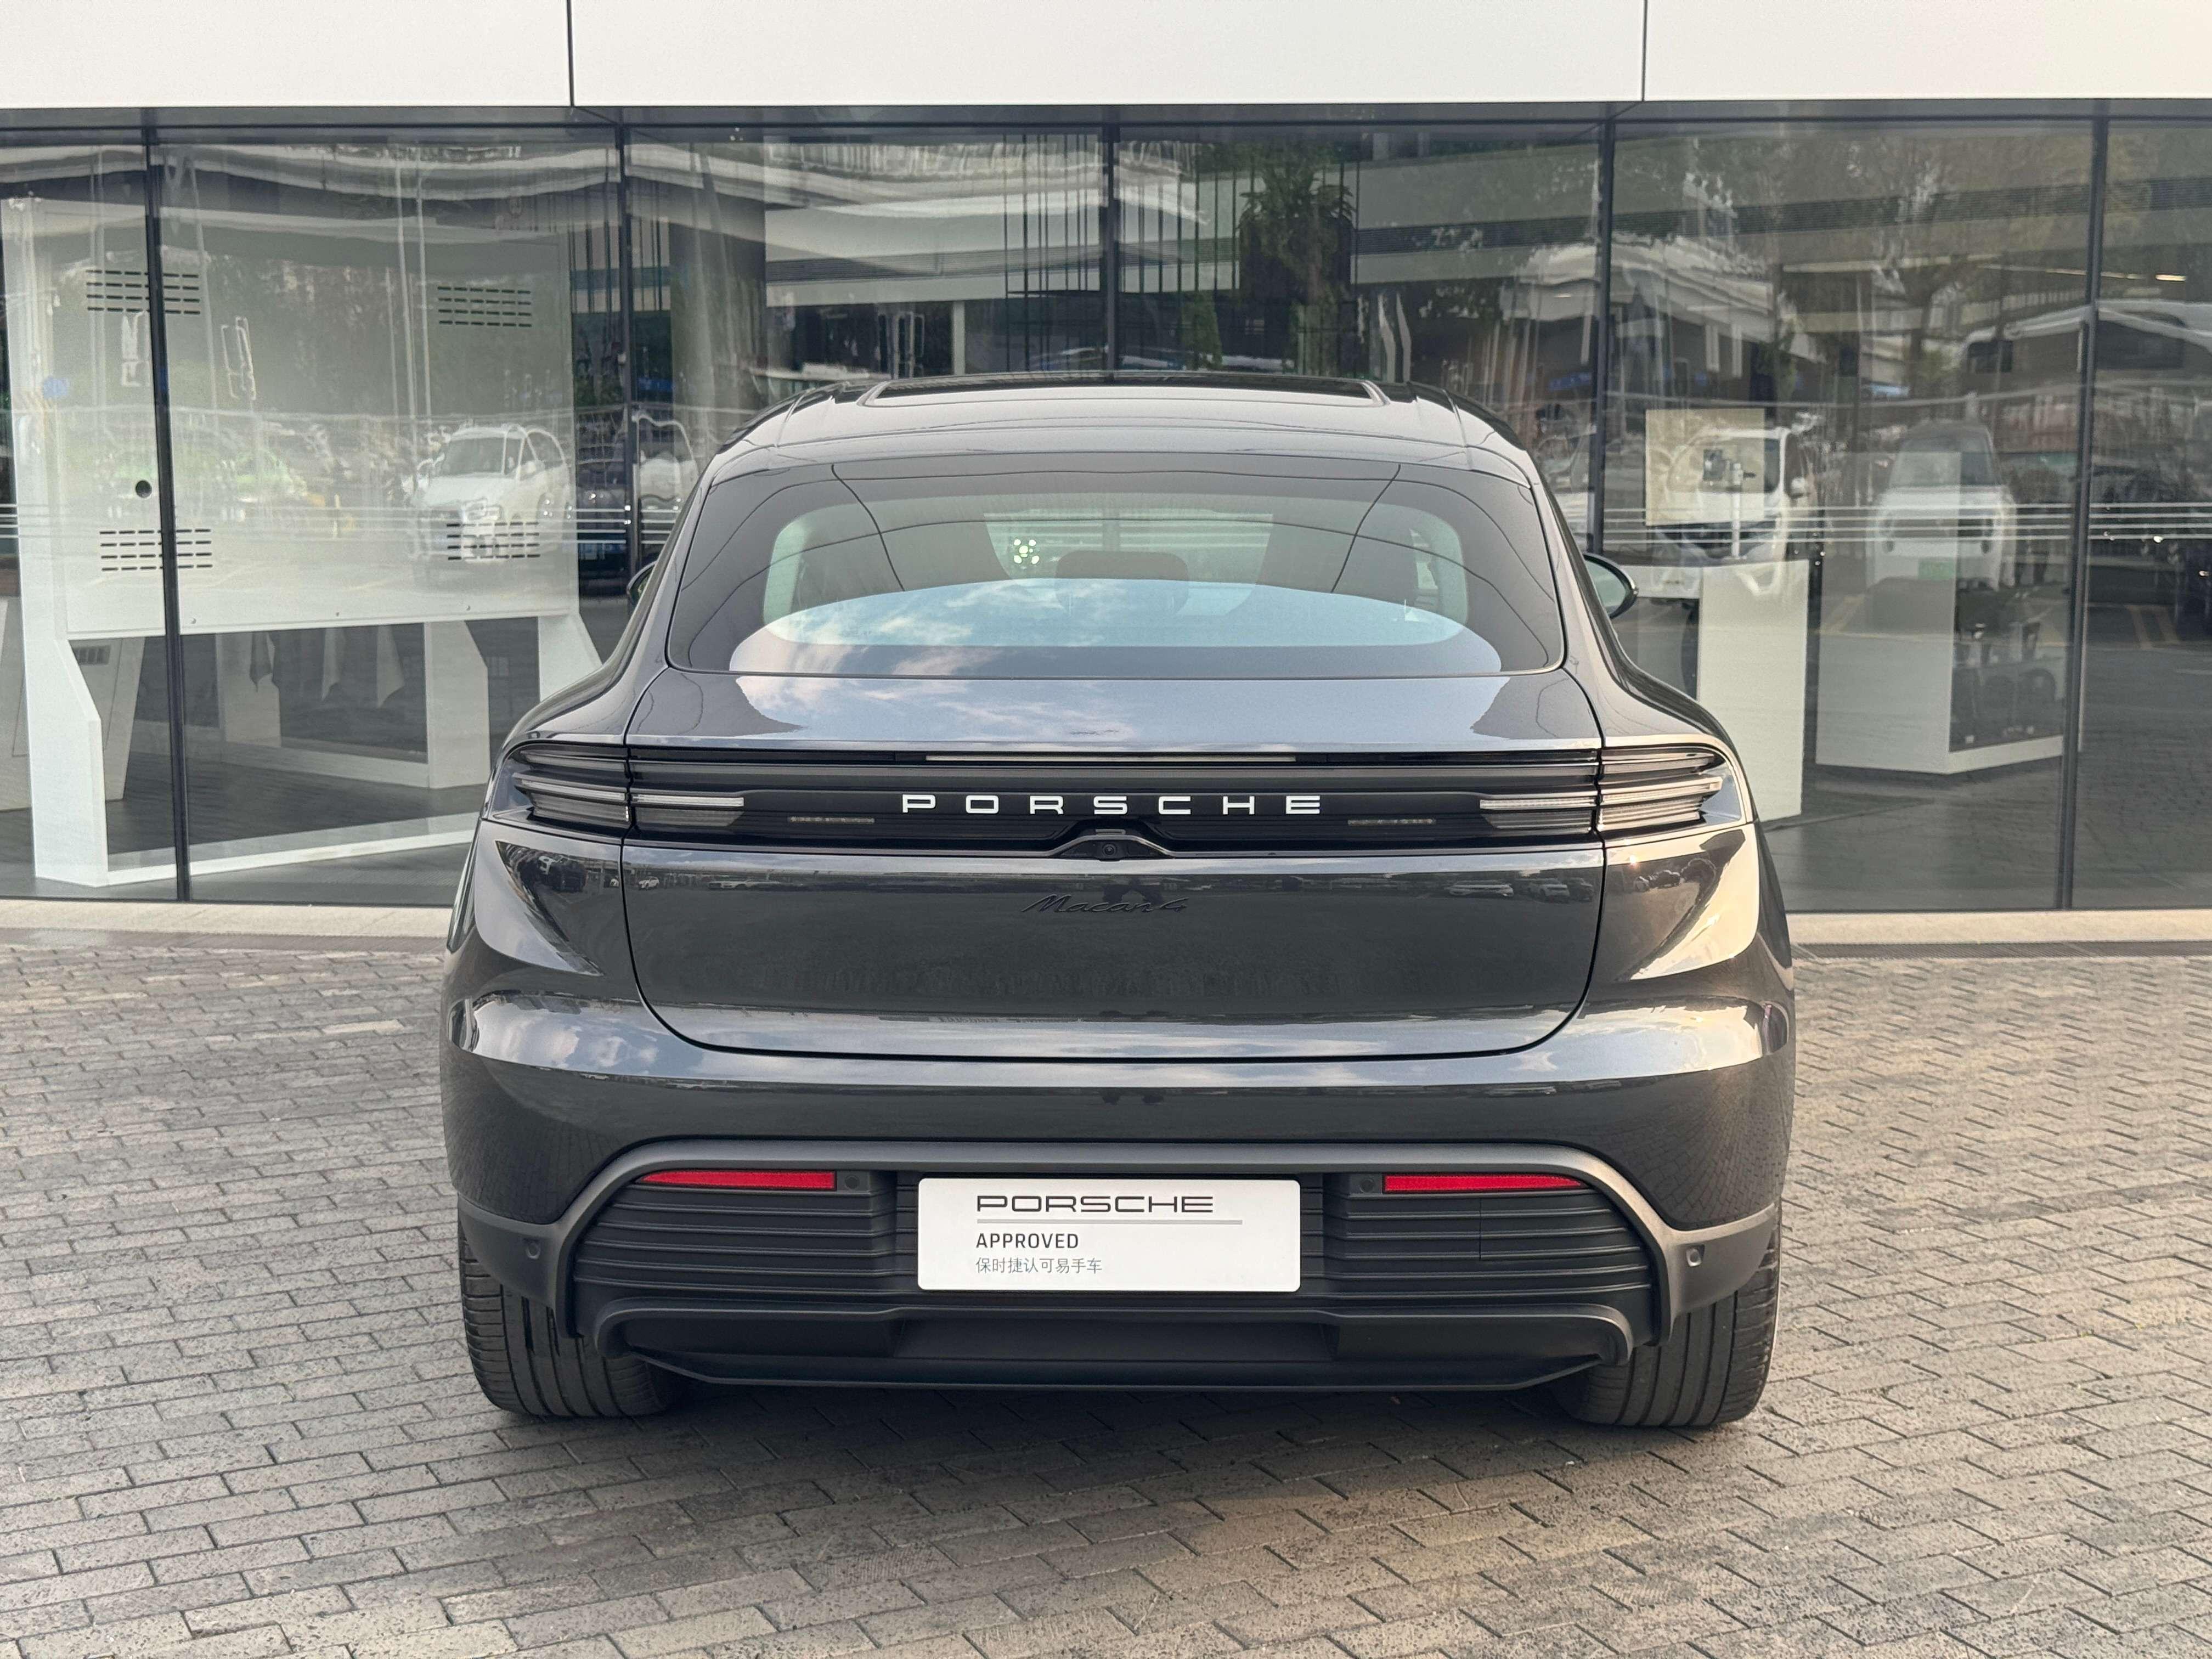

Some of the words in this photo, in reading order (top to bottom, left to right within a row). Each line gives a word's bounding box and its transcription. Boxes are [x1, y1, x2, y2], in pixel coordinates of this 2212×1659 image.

[902, 794, 1321, 815] PORSCHE
[1021, 894, 1153, 912] Macan
[1159, 897, 1189, 912] 4
[977, 1195, 1213, 1213] PORSCHE
[976, 1233, 1079, 1249] APPROVED
[975, 1257, 1102, 1274] 保时捷认可易手车
